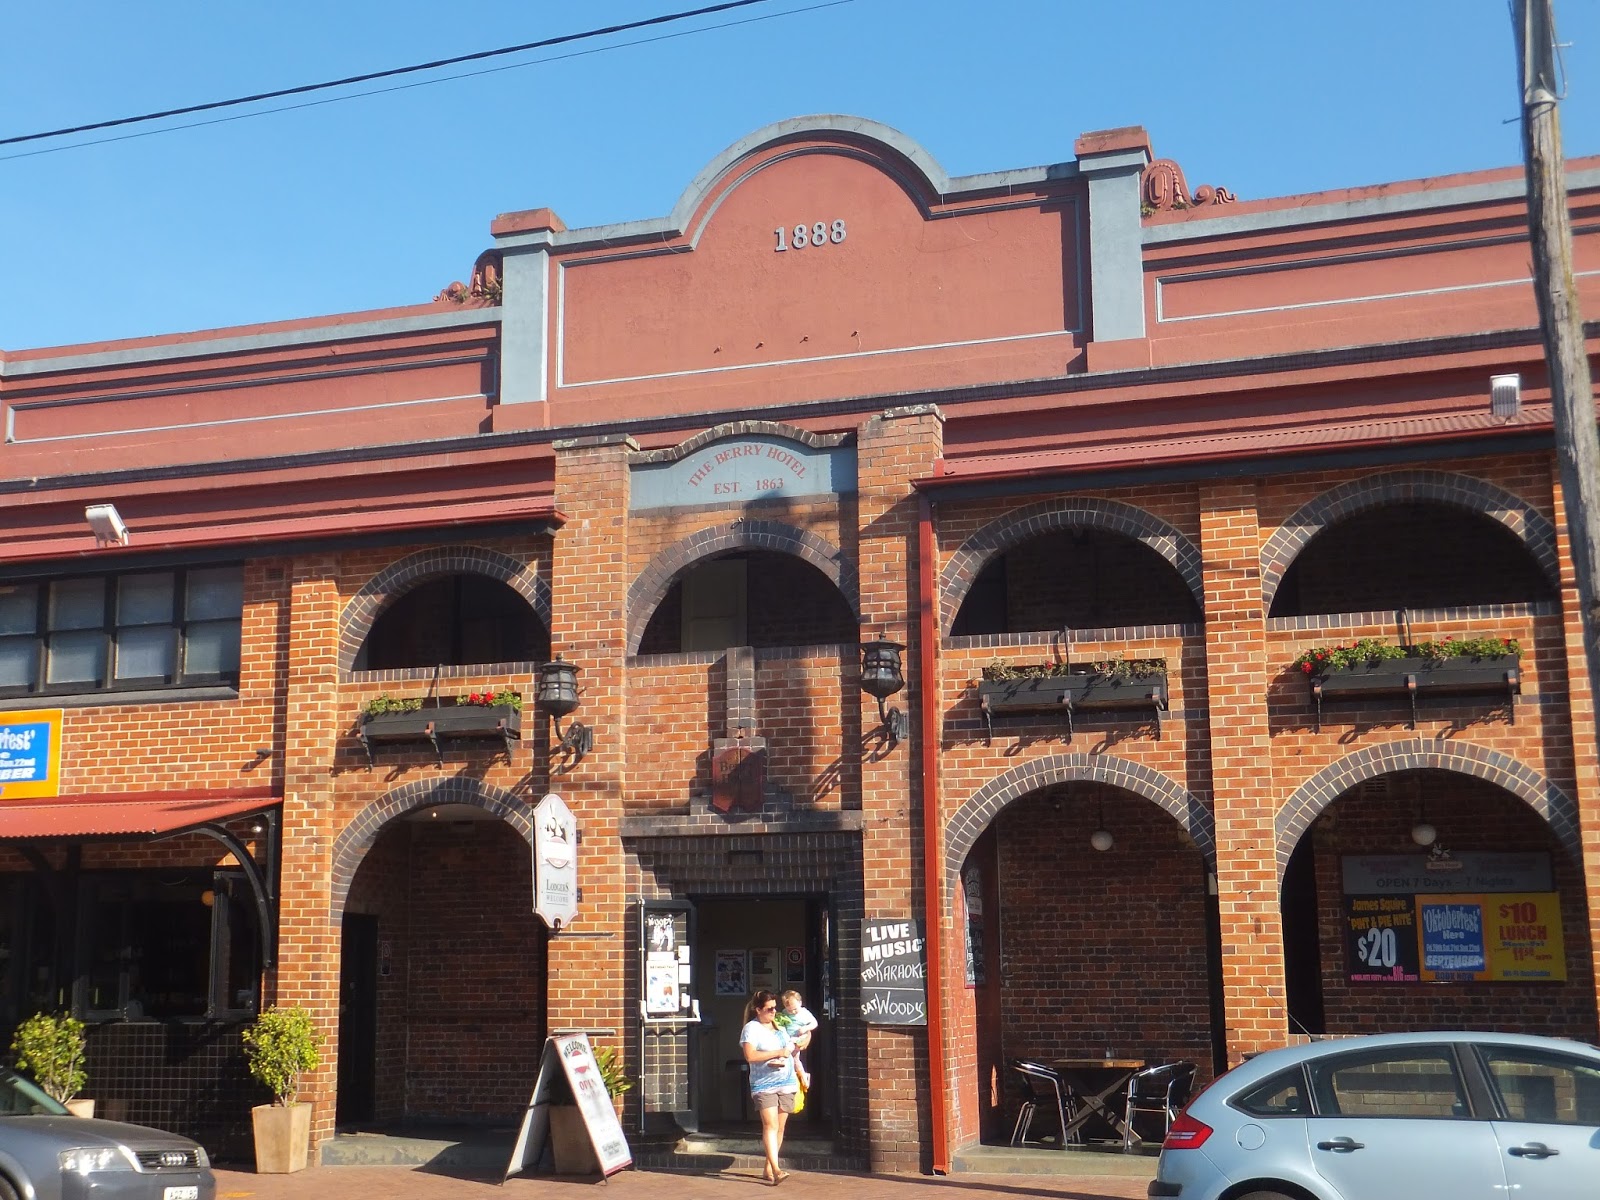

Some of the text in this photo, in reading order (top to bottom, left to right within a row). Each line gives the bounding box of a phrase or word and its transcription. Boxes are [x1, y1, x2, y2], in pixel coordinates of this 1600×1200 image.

[775, 219, 847, 252] 1888
[688, 444, 807, 487] THE BERRY HOTEL
[714, 478, 784, 494] EST. 1863
[1376, 877, 1409, 888] OPEN
[1423, 877, 1450, 889] Days
[1499, 902, 1537, 924] $10
[1442, 929, 1465, 940] Here
[1499, 925, 1547, 940] LUNCH
[1357, 927, 1397, 968] $20
[1426, 954, 1480, 967] SEPTEMBER
[861, 959, 928, 982] FRI KARAOKE
[861, 999, 878, 1015] SAT
[563, 1041, 587, 1058] WELCOME
